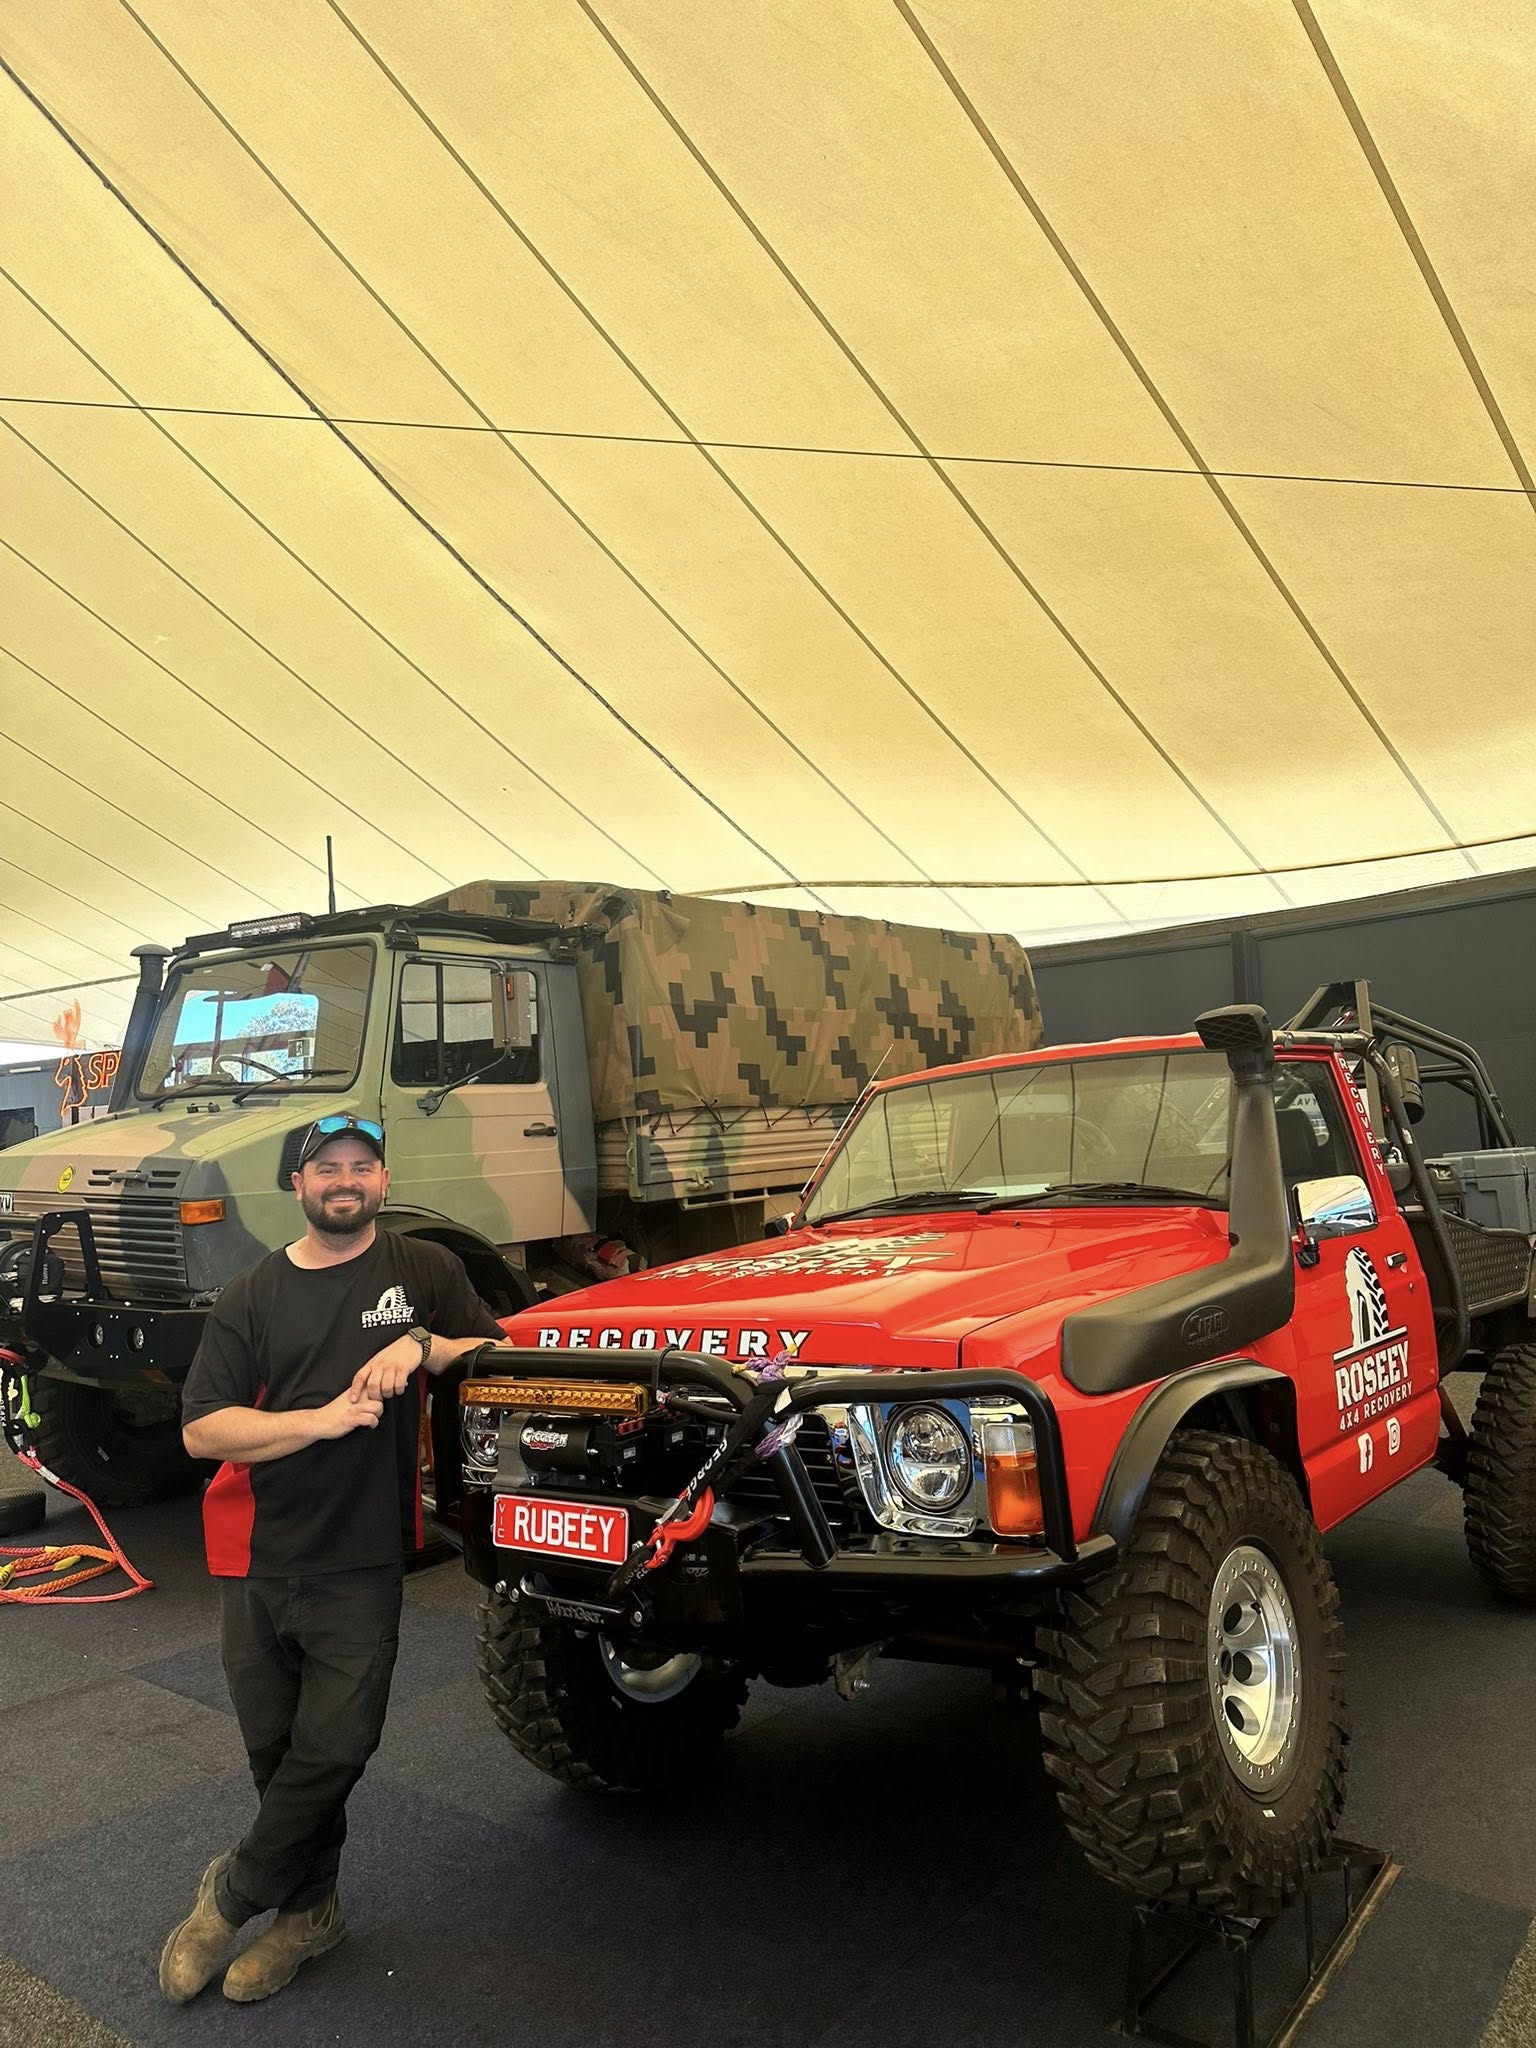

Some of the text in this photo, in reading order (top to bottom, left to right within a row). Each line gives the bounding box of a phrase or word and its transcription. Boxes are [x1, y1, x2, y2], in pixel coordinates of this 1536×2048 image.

[1337, 1056, 1386, 1177] RECOVERY
[538, 1328, 812, 1358] RECOVERY
[1334, 1340, 1410, 1411] ROSEEY
[1340, 1380, 1413, 1431] 4X4 RECOVERY
[514, 1505, 615, 1554] RUBEEY
